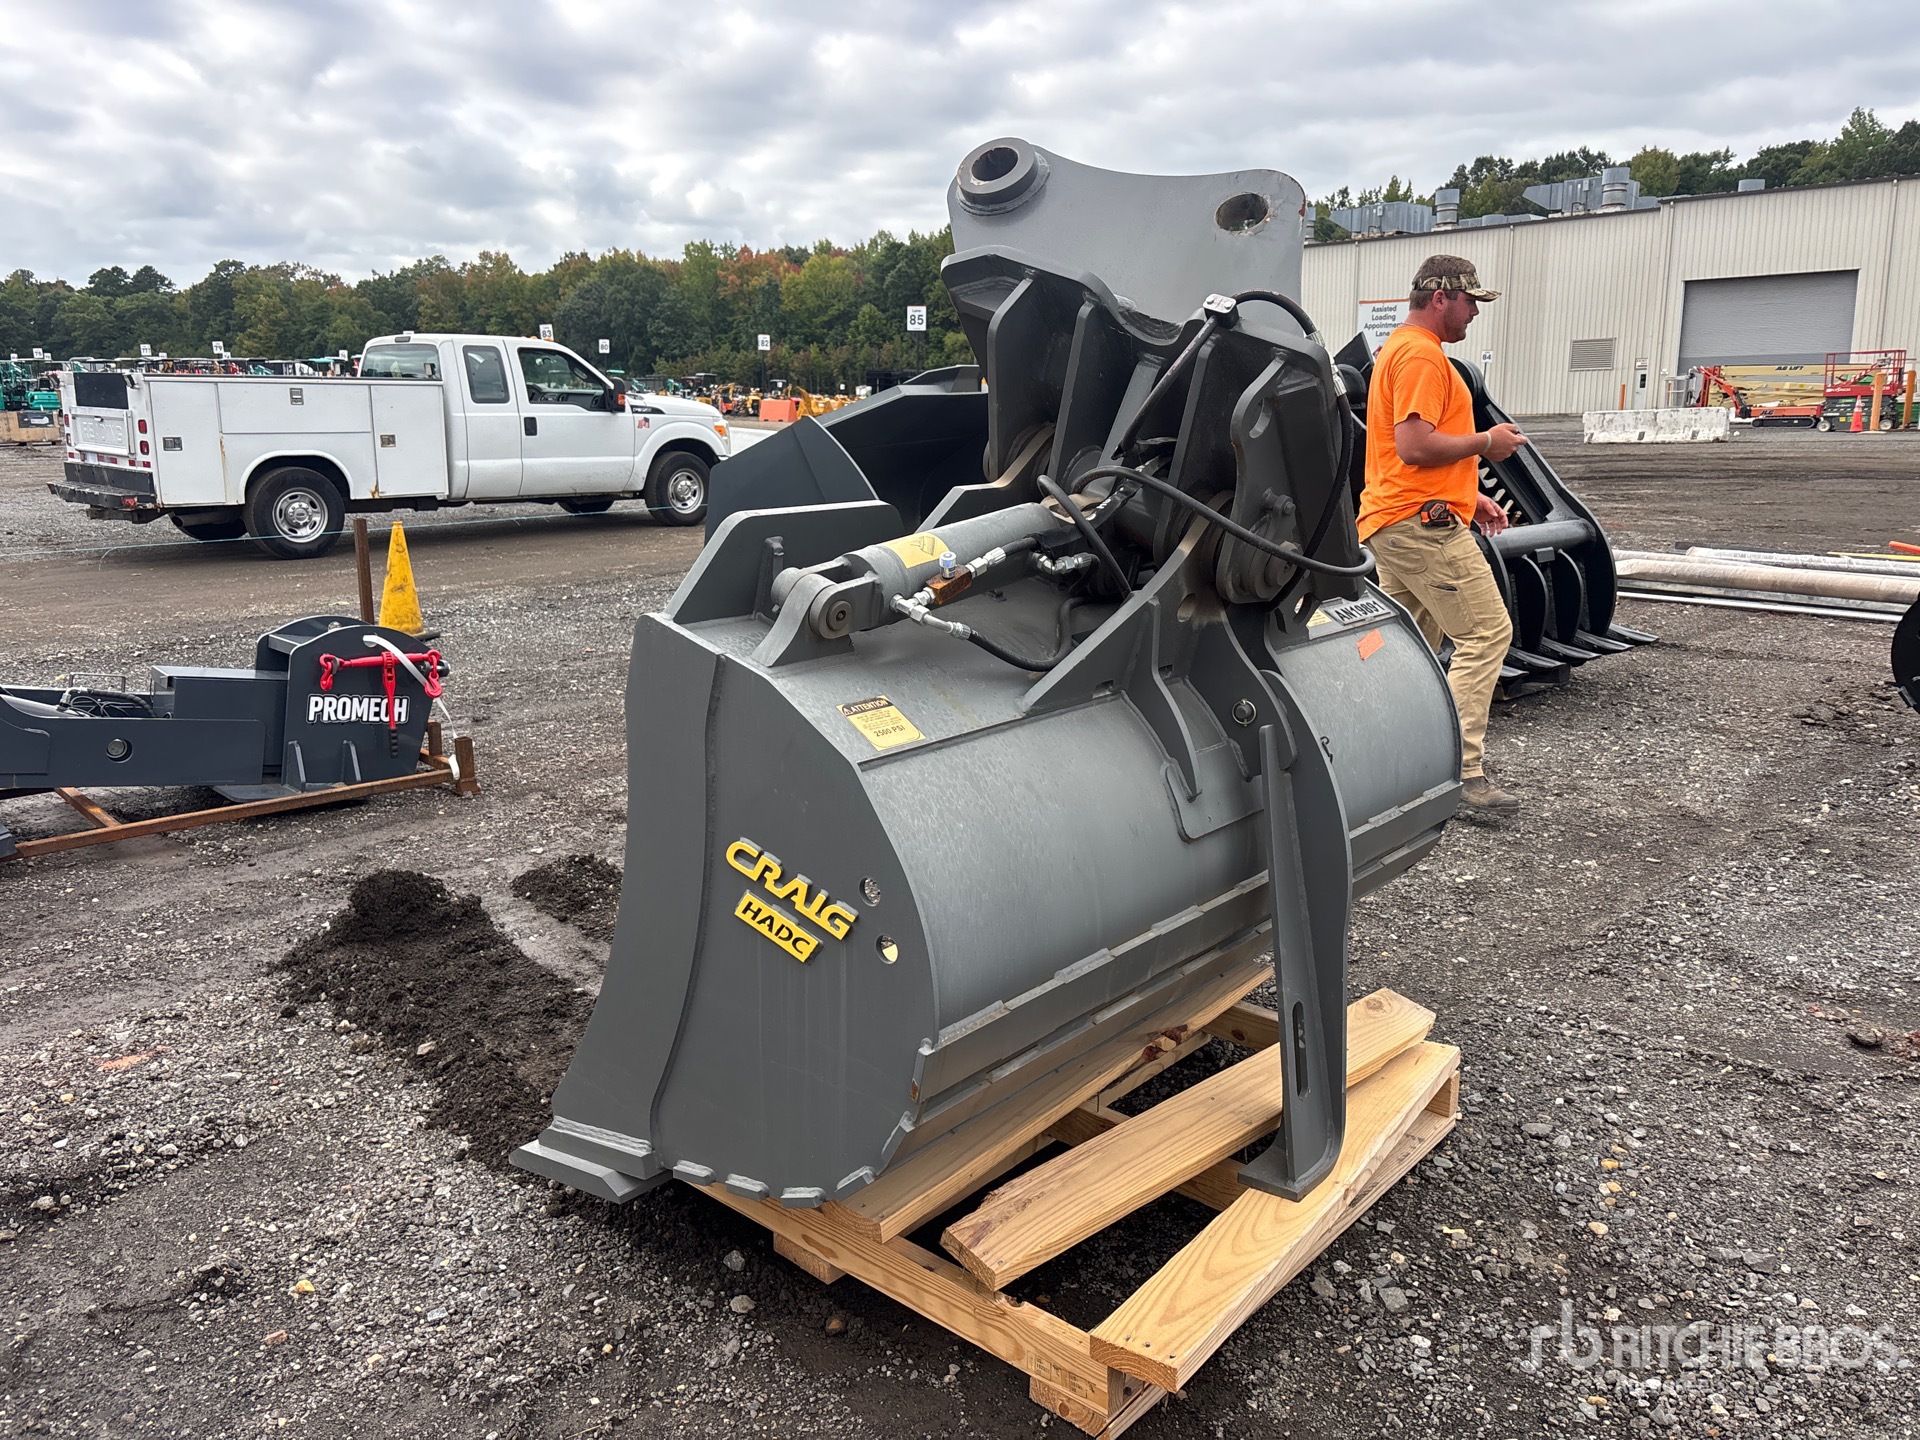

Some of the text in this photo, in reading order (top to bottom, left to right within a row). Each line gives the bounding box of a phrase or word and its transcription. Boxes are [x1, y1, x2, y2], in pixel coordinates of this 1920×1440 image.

[909, 314, 924, 325] 85
[541, 329, 552, 338] 83
[600, 343, 609, 351] 80
[760, 339, 769, 347] 82
[1334, 600, 1386, 622] AN19891
[307, 695, 409, 723] PROMECH
[850, 699, 889, 713] ATTENTION
[873, 724, 906, 738] 2500 PSI
[726, 839, 858, 941] CRAIG
[741, 901, 811, 955] HADC
